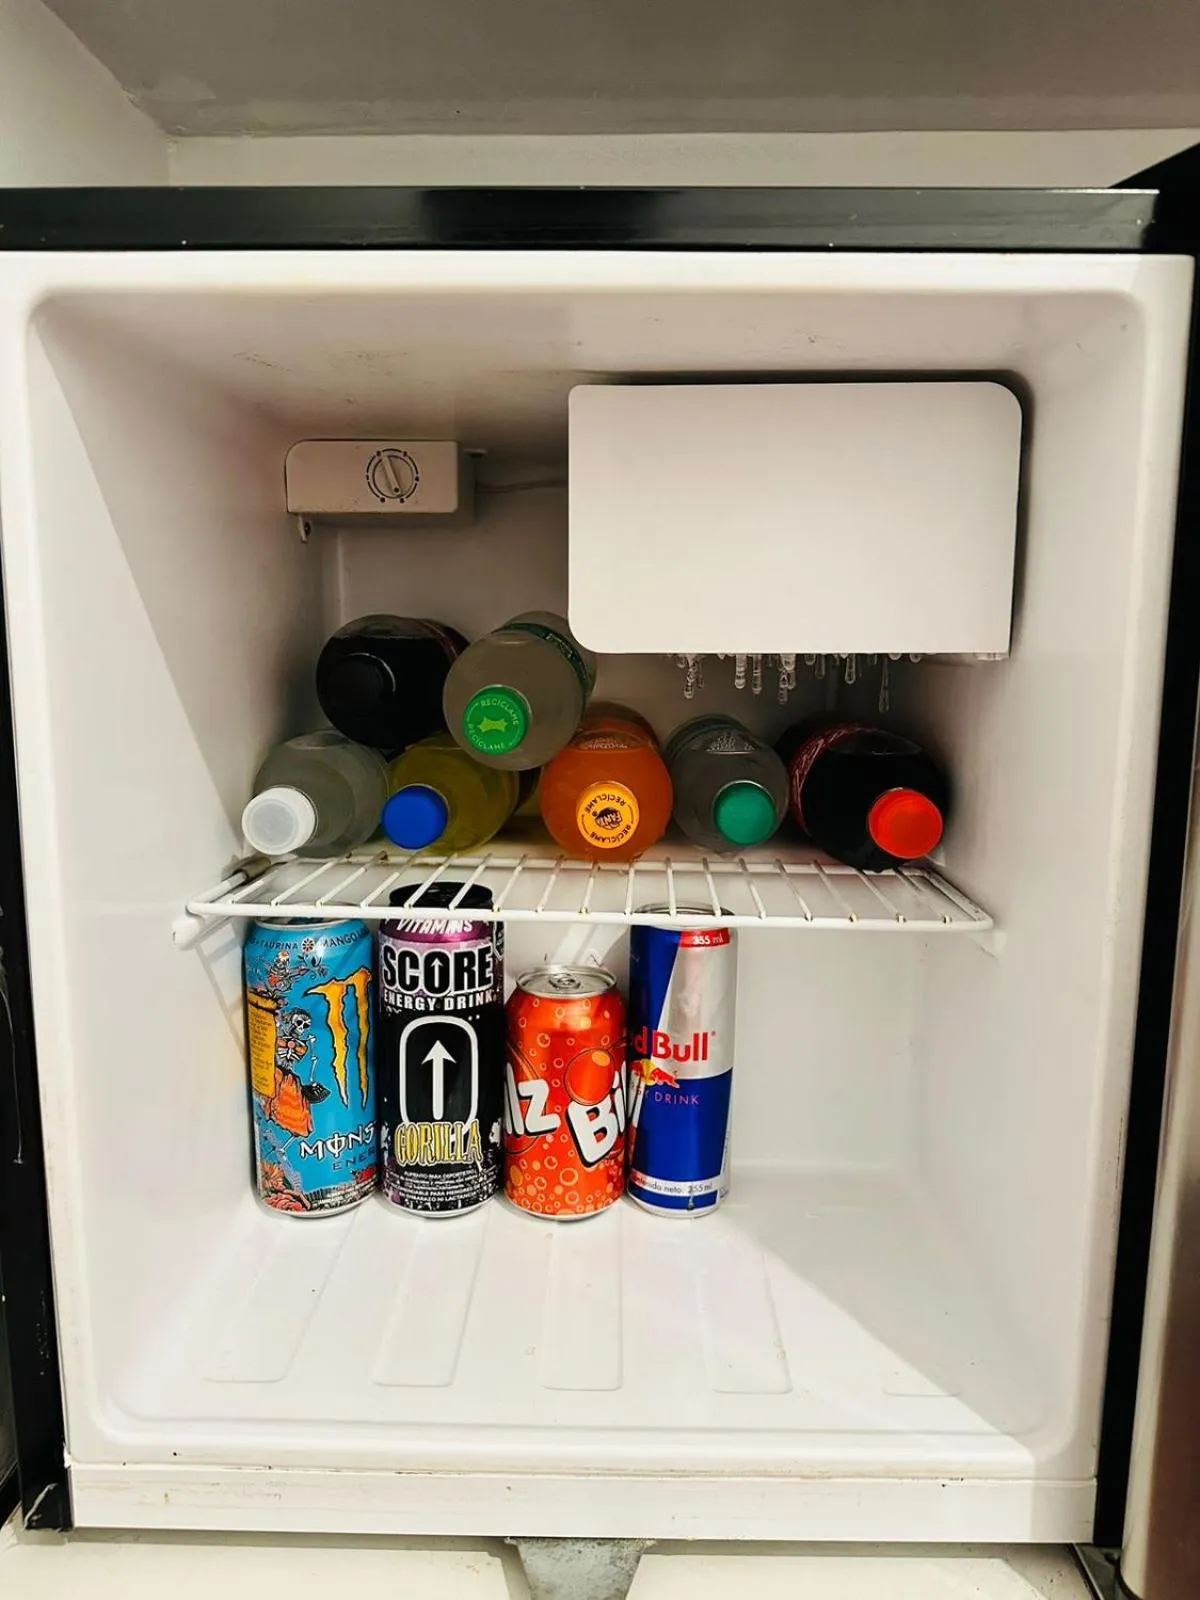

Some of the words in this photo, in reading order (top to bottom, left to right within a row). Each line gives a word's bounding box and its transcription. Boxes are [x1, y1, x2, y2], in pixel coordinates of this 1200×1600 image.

[396, 918, 473, 935] VITAMINS
[692, 934, 711, 945] 355
[712, 933, 723, 944] ml
[382, 943, 494, 996] SCORE
[384, 990, 436, 1011] ENERGY
[443, 990, 493, 1011] DRINK
[654, 1092, 699, 1105] DRINK
[394, 1119, 483, 1167] GORILLA
